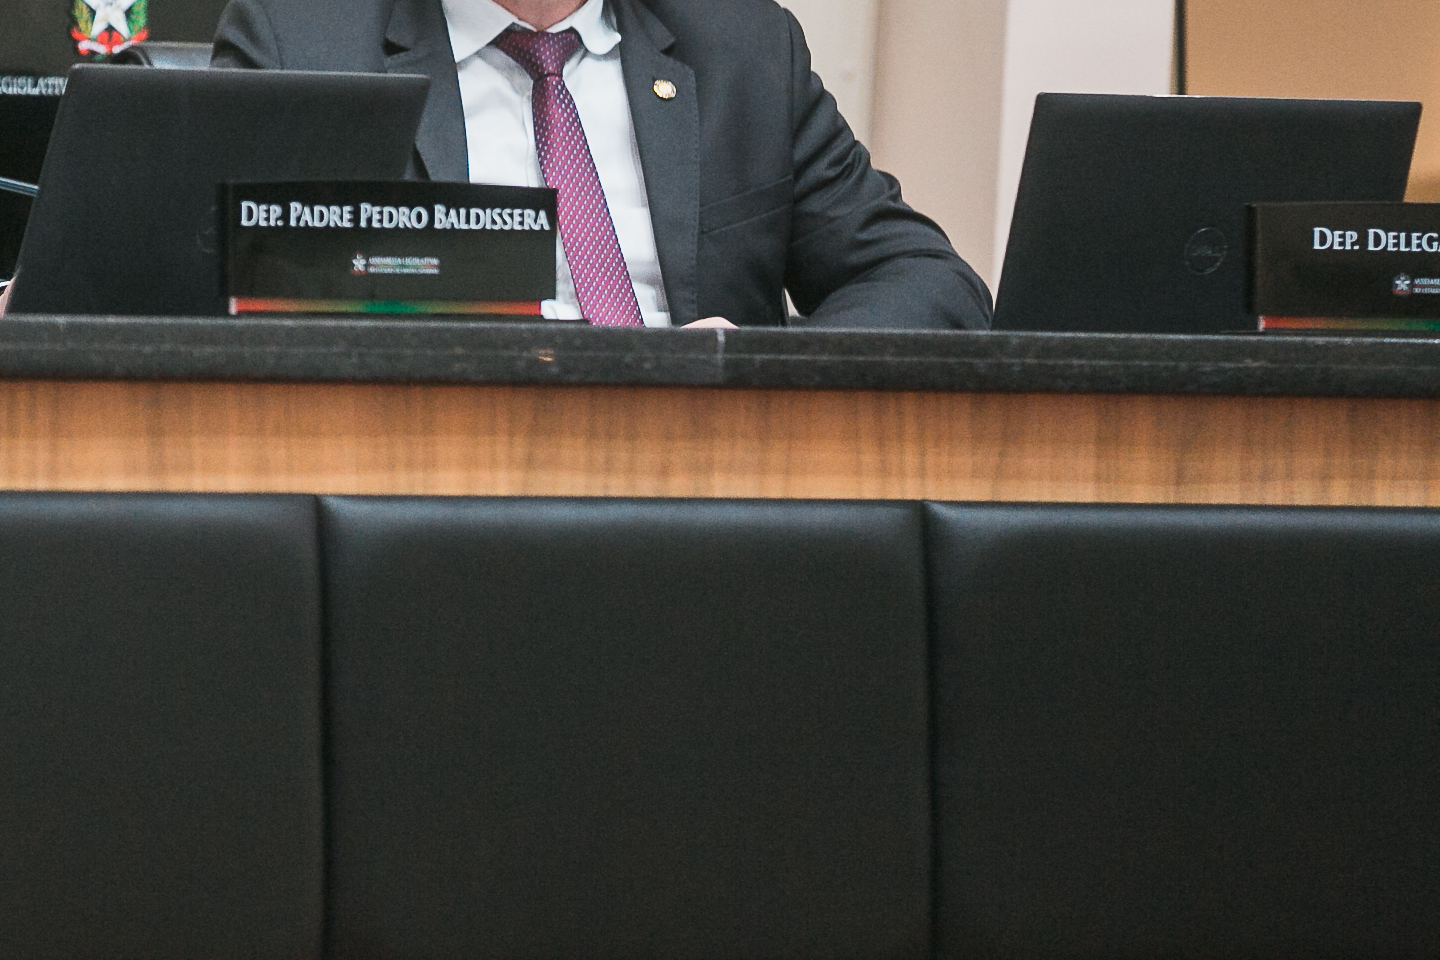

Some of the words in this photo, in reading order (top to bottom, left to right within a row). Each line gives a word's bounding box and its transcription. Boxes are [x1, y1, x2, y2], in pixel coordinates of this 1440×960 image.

[240, 200, 284, 227] DEP.
[289, 201, 355, 228] PADRE
[359, 202, 429, 229] PEDRO
[433, 203, 551, 231] BALDISSERA
[1312, 226, 1360, 250] DEP.
[1366, 228, 1440, 252] DELEG
